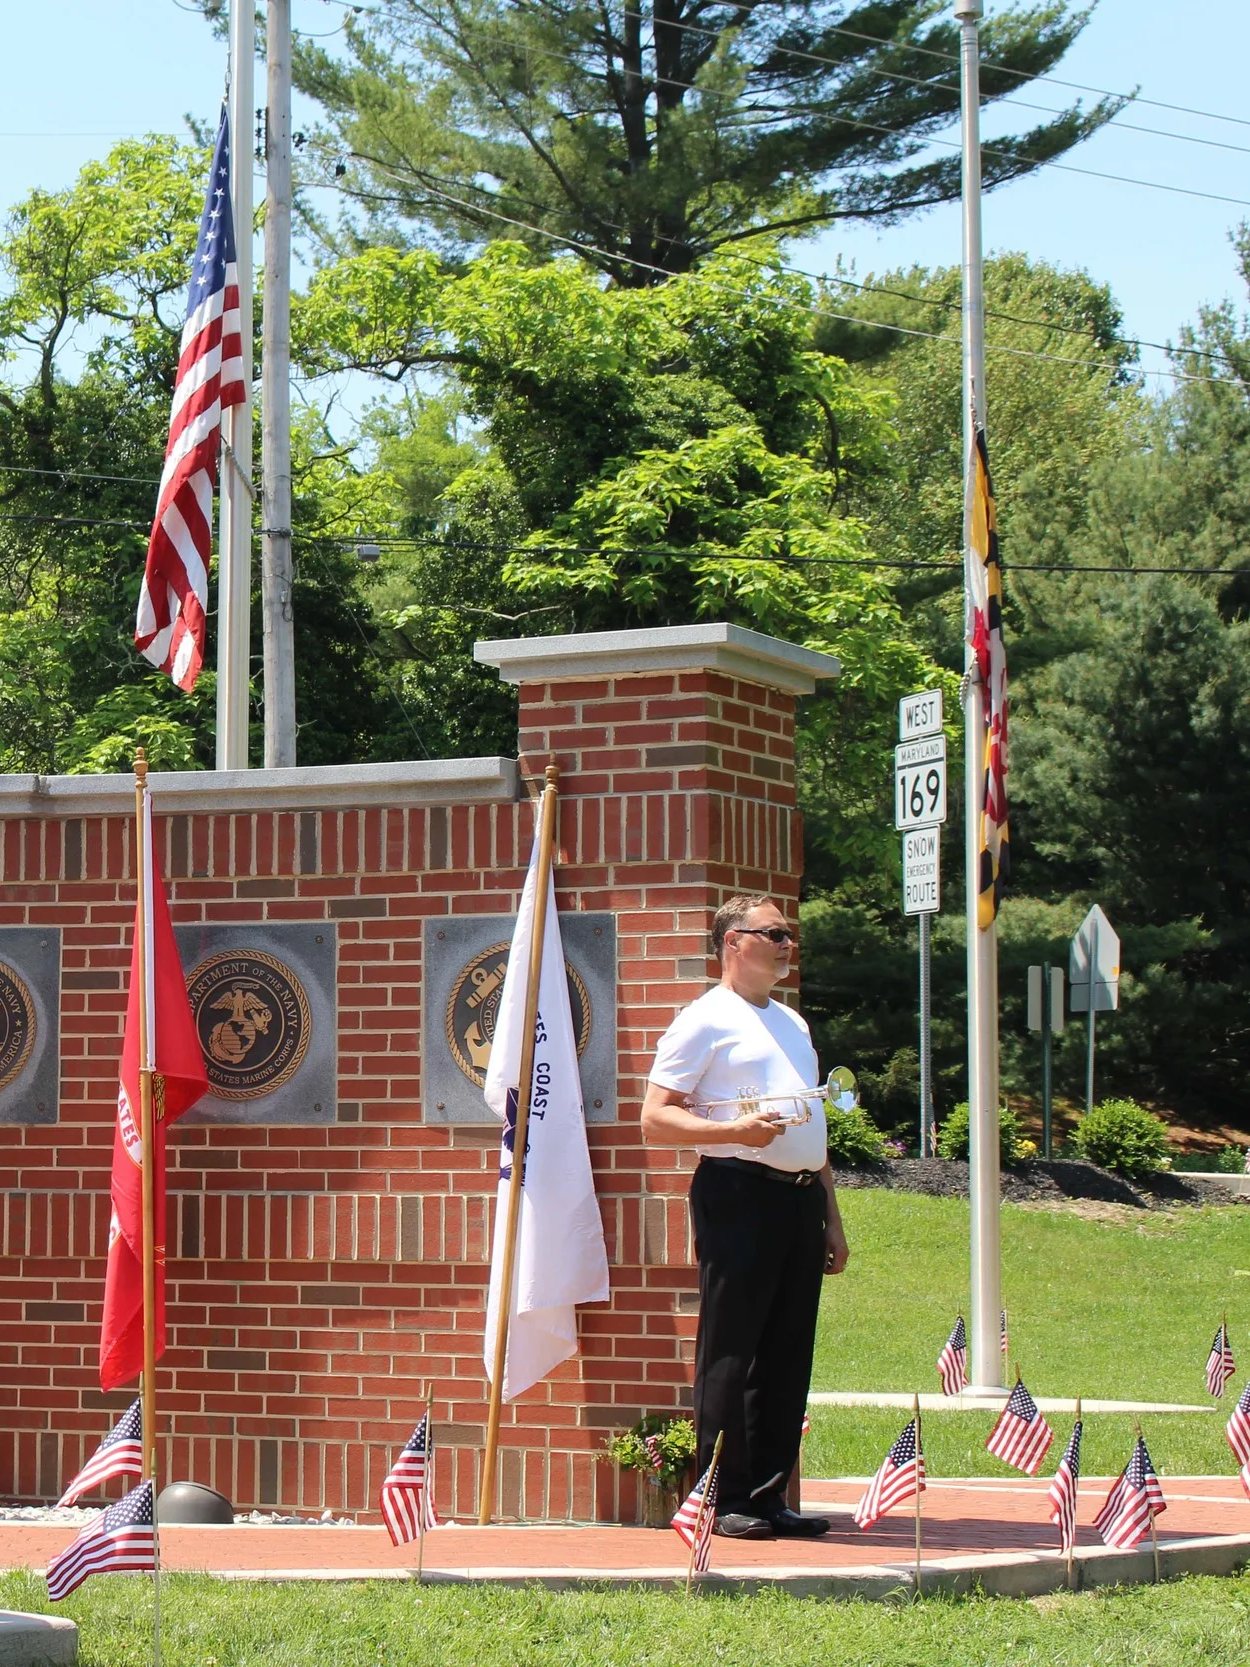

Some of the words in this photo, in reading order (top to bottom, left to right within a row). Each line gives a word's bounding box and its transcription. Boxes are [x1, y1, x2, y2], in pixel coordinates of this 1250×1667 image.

[906, 701, 935, 730] WEST
[900, 743, 940, 762] MARYLAND
[900, 769, 940, 820] 169
[907, 836, 935, 859] SNOW
[906, 862, 936, 878] EMERGENCY
[906, 881, 937, 905] ROUTE
[2, 985, 22, 1014] NAVY
[189, 962, 249, 1013] PARTMENT
[252, 967, 266, 977] OF
[266, 974, 283, 991] THE
[280, 989, 298, 1028] NAVY
[208, 1068, 240, 1084] STATES
[242, 1065, 276, 1084] MARINE
[274, 1038, 294, 1067] CORPS
[532, 1062, 551, 1121] COAST
